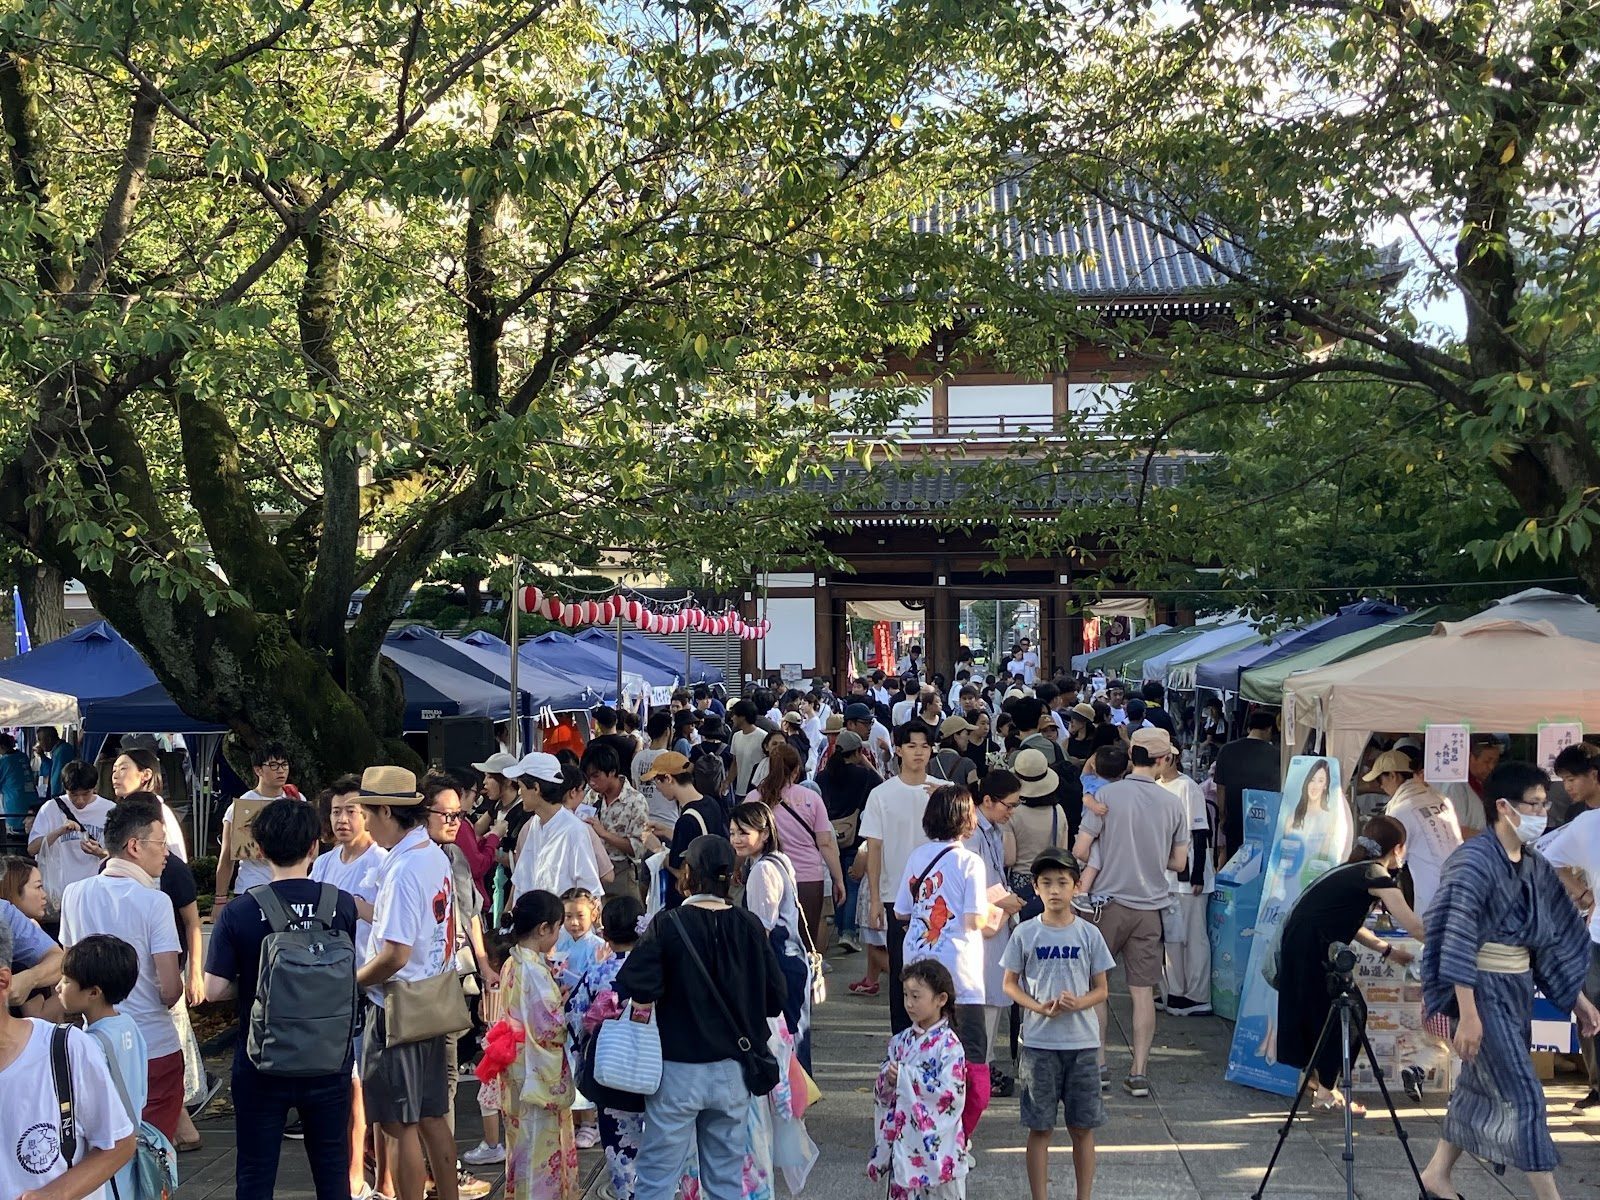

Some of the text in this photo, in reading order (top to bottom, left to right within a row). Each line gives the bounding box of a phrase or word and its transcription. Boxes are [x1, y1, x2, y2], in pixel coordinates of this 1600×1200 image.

[1433, 750, 1442, 773] セール
[1035, 945, 1081, 960] WASK
[1359, 965, 1395, 978] 抽選会
